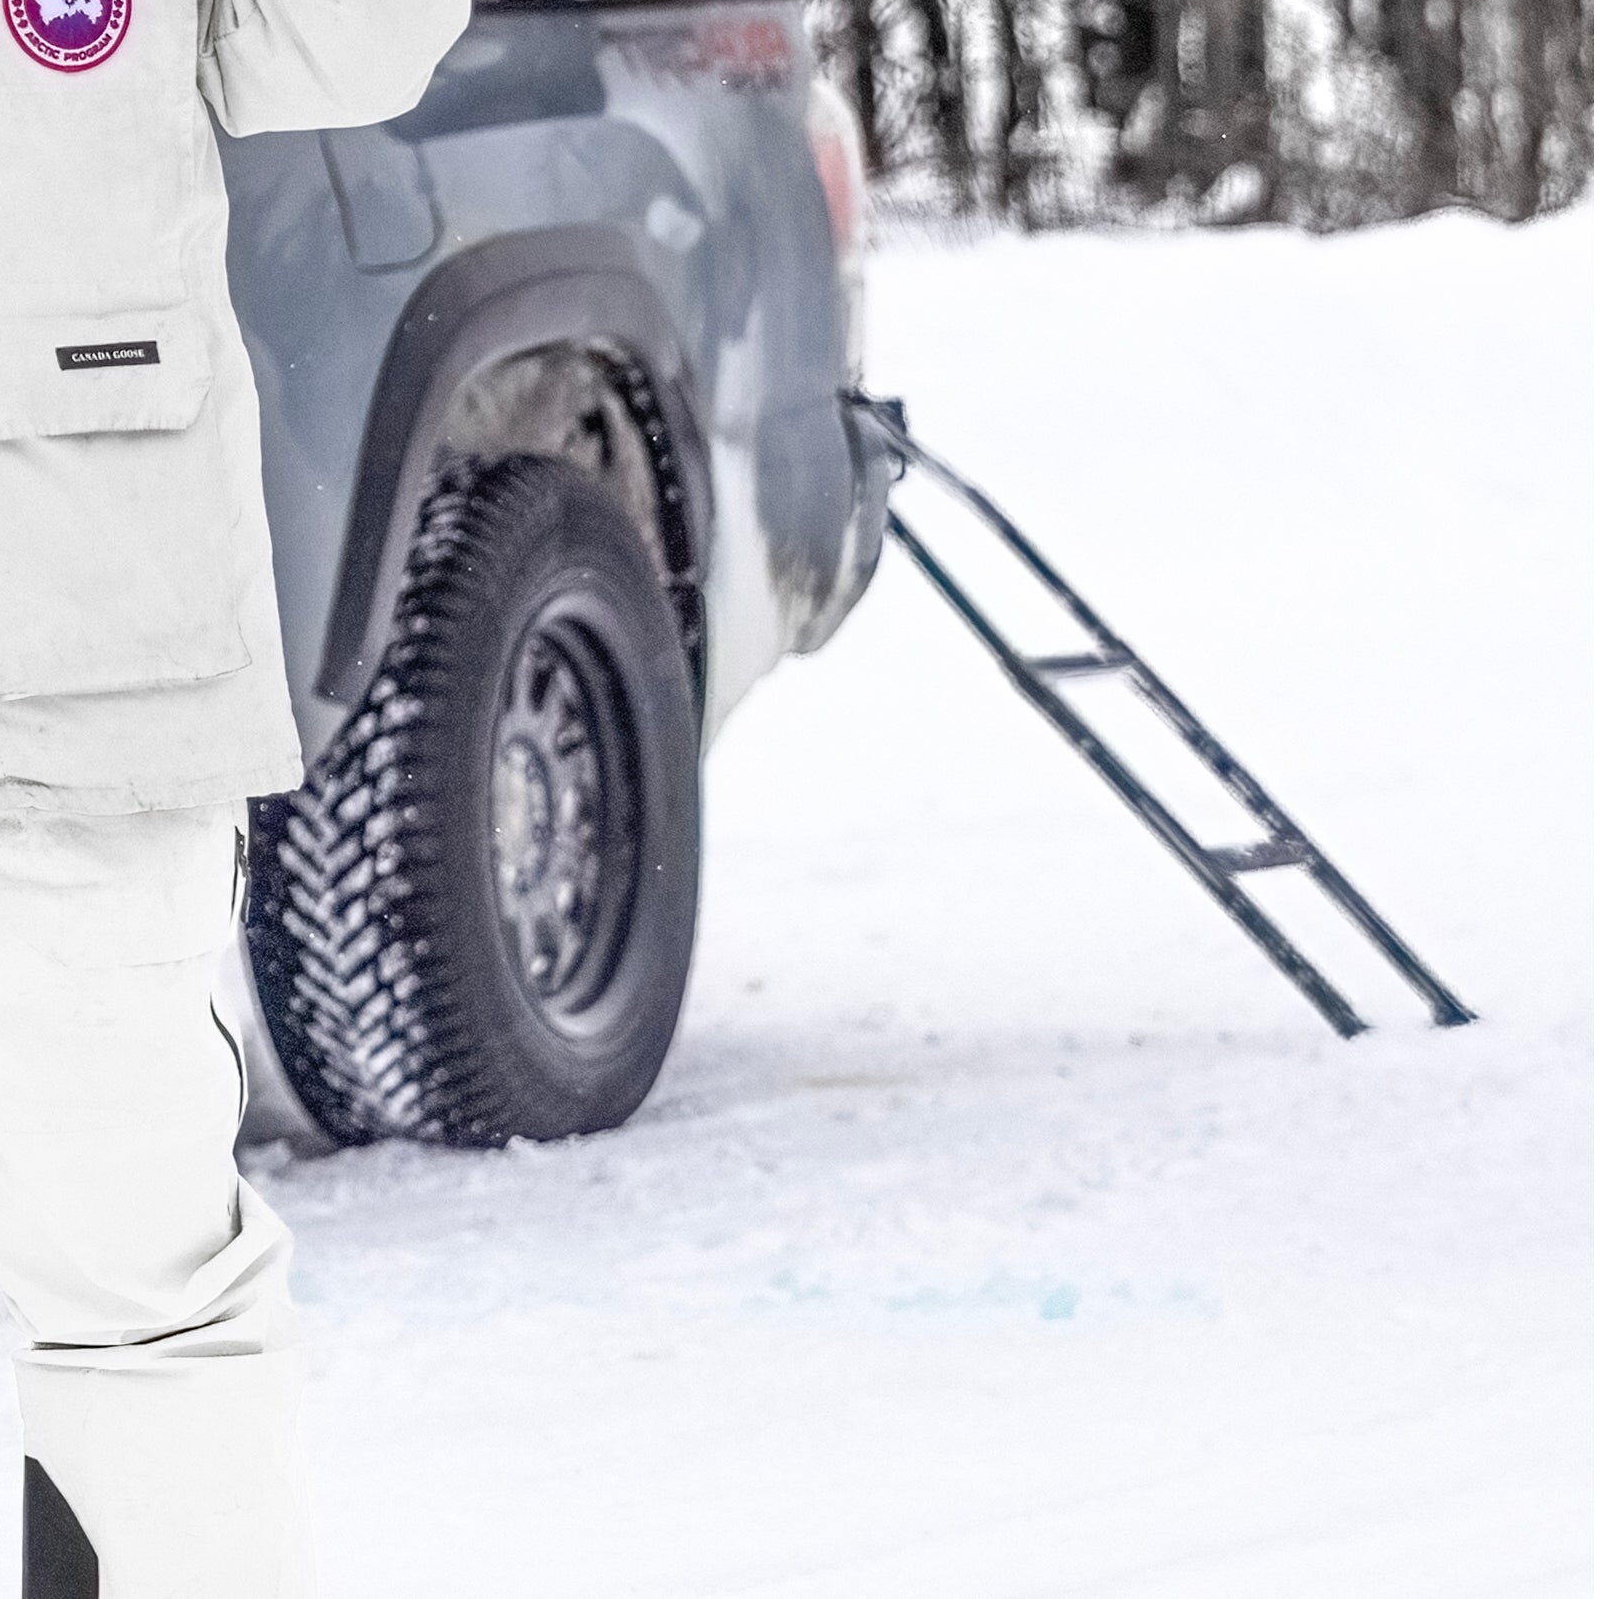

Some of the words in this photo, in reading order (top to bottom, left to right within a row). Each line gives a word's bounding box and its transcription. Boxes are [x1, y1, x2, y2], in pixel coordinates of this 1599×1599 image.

[25, 32, 61, 60] ARCTIC
[63, 33, 113, 62] PROGRAM
[71, 351, 112, 363] CANADA
[112, 348, 145, 359] GOOSE
